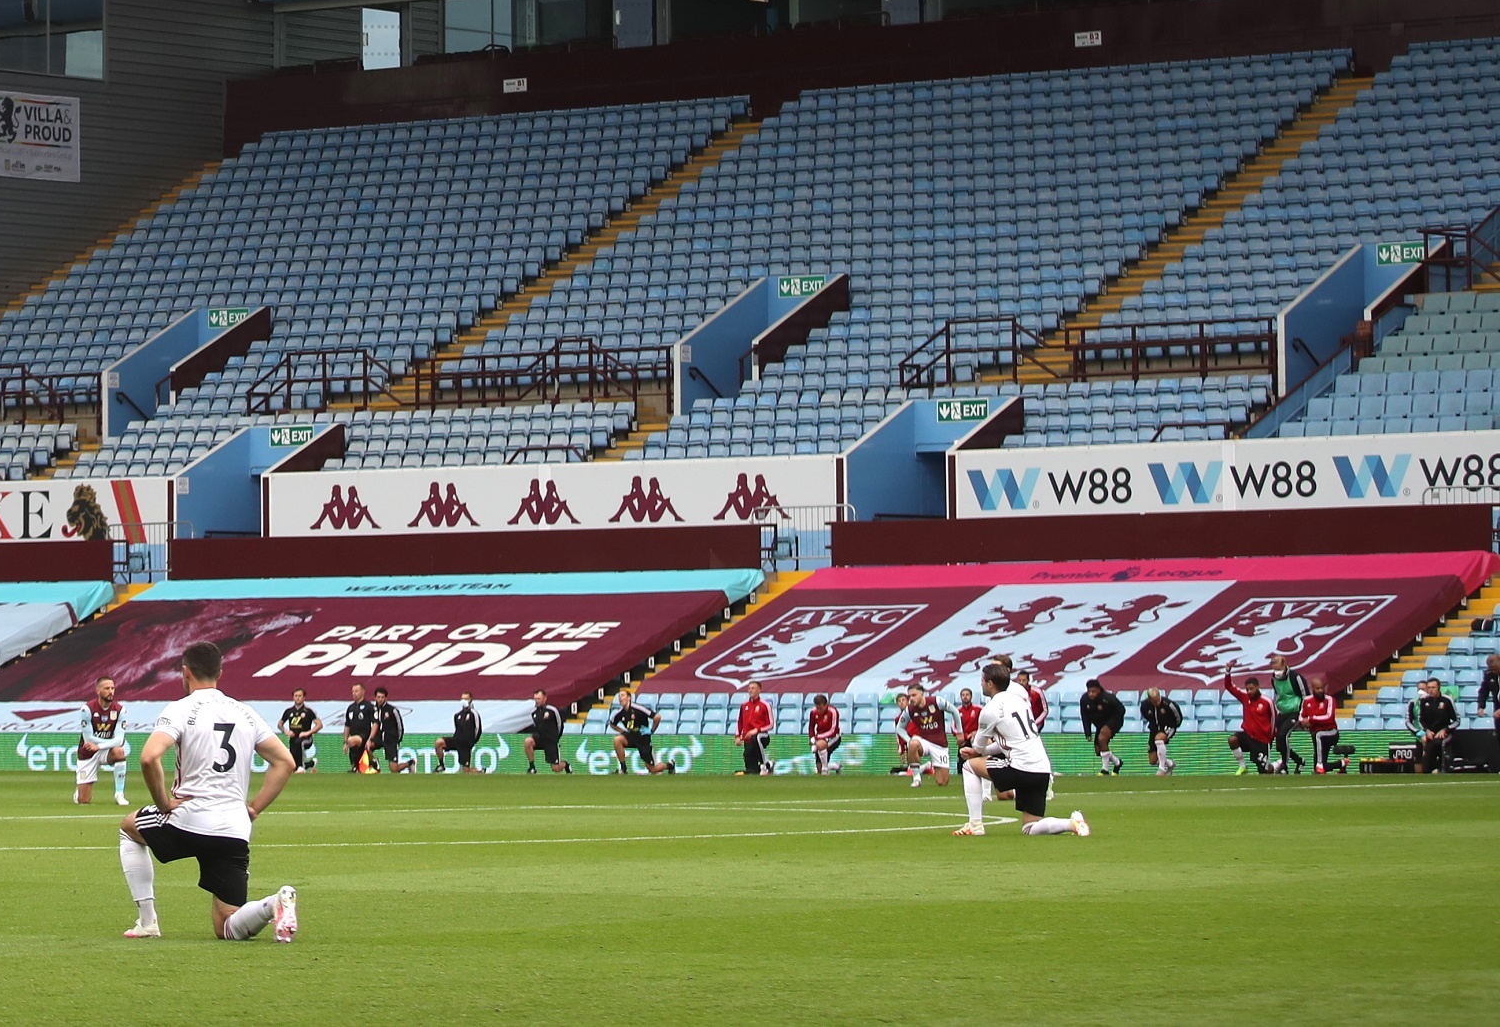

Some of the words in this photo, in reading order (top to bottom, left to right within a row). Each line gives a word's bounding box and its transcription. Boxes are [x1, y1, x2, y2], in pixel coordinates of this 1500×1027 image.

[24, 125, 73, 143] PROUD
[1403, 246, 1424, 259] EXIT
[802, 281, 824, 292] EXIT
[230, 311, 249, 323] EXIT
[962, 403, 986, 417] EXIT
[291, 429, 312, 443] EXIT
[1048, 467, 1132, 505] W88
[1230, 460, 1317, 499] W88
[1030, 570, 1108, 581] Premier
[1141, 568, 1224, 579] League
[344, 584, 374, 592] WE
[374, 584, 414, 592] ARE
[414, 583, 456, 591] ONE
[456, 582, 512, 591] TEAM
[784, 608, 908, 626] AVFC
[1241, 600, 1377, 618] AVFC
[313, 623, 449, 642] PART
[446, 623, 520, 641] OF
[521, 621, 622, 640] THE
[252, 640, 589, 677] PRIDE
[1012, 709, 1040, 740] 16
[212, 722, 237, 773] 3
[940, 752, 948, 765] 10
